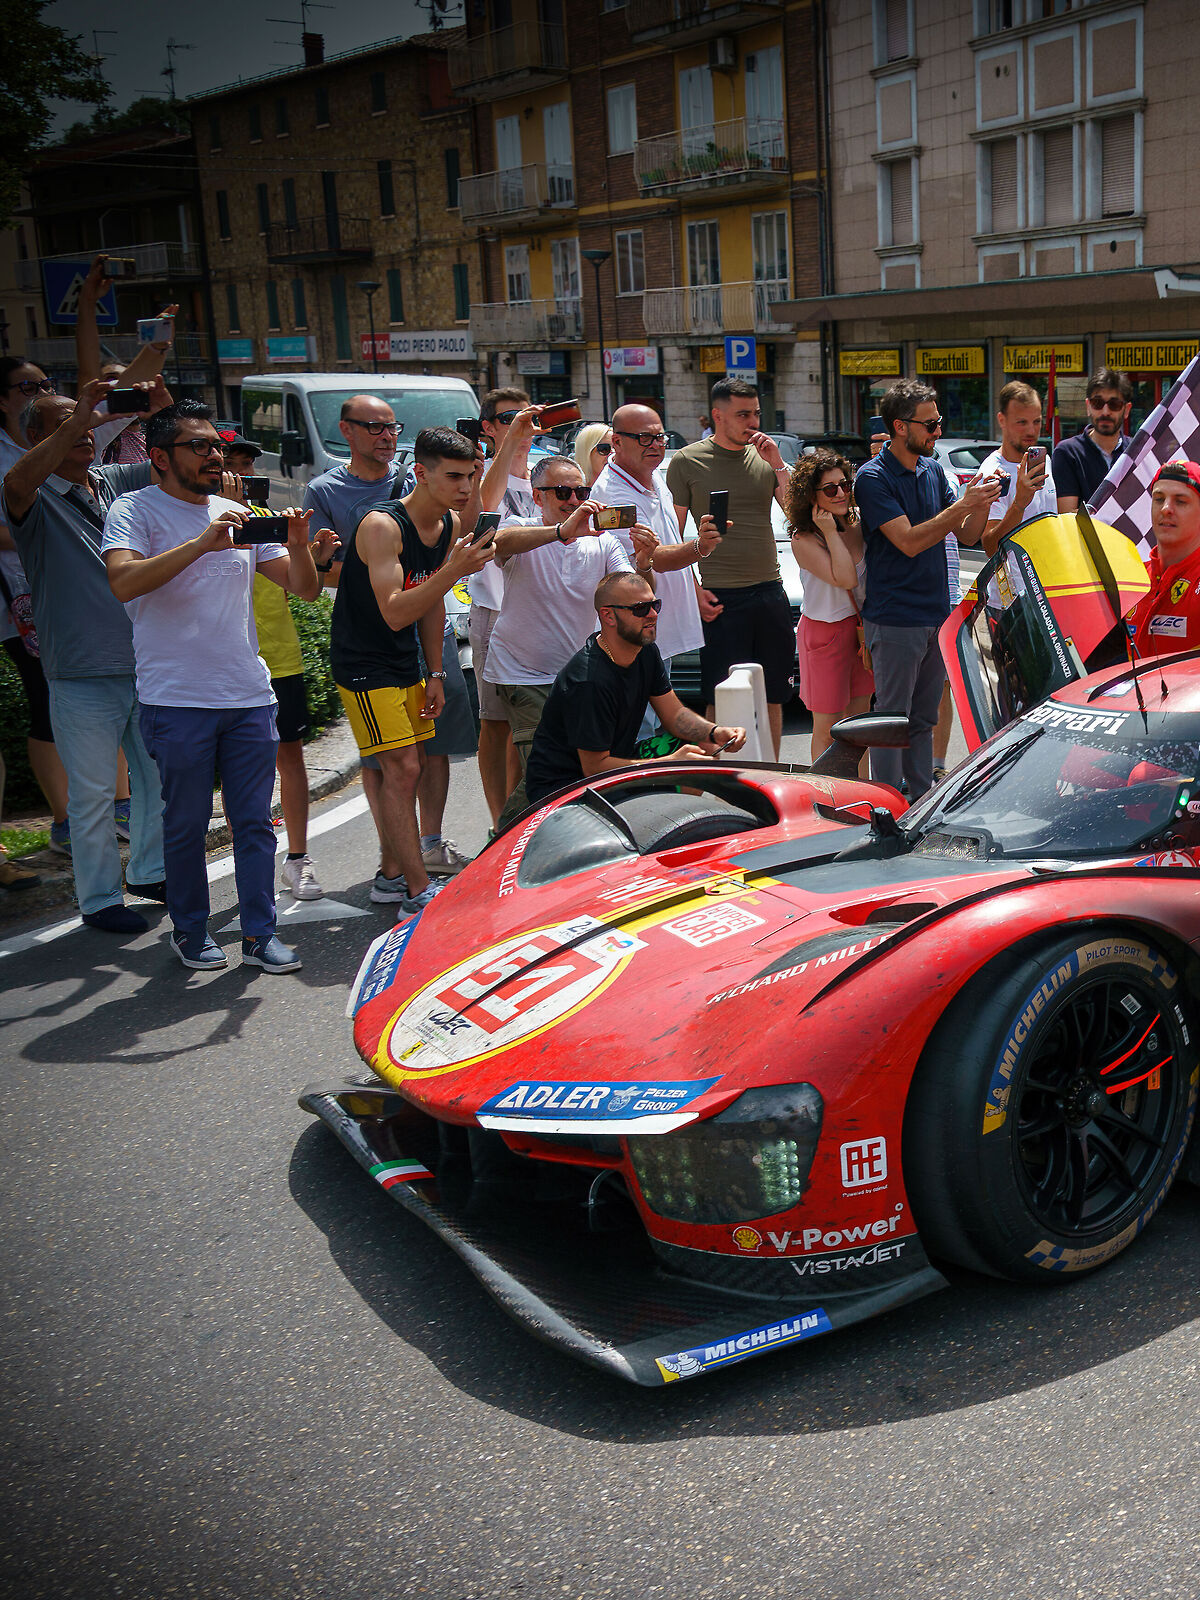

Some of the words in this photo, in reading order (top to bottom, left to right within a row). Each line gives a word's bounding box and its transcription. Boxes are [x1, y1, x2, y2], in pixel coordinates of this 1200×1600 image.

[390, 339, 410, 353] RICCI
[413, 338, 436, 353] PIERO
[438, 338, 466, 353] PAOLO
[731, 340, 750, 365] P
[1106, 346, 1151, 367] GIORGIO
[922, 351, 969, 372] Giocattoli
[1006, 348, 1072, 370] Modellimo
[1041, 605, 1054, 630] CALADO
[1151, 616, 1184, 628] WEC
[1054, 643, 1072, 679] GIOVINAZZI
[1020, 700, 1130, 735] Ferrari
[511, 805, 553, 856] RICHARD
[498, 857, 522, 898] MILLE
[671, 914, 732, 943] CAR
[705, 905, 756, 930] HYPER
[1086, 946, 1112, 962] PILOT
[1113, 945, 1141, 957] SPORT
[707, 962, 808, 1005] RICHARD
[428, 1011, 472, 1035] WEC
[998, 961, 1072, 1080] MICHELIN
[495, 1085, 611, 1109] ADLER
[642, 1087, 688, 1098] PELZER
[633, 1100, 677, 1111] GROUP
[767, 1214, 902, 1253] V-Power
[704, 1313, 819, 1361] MICHELIN
